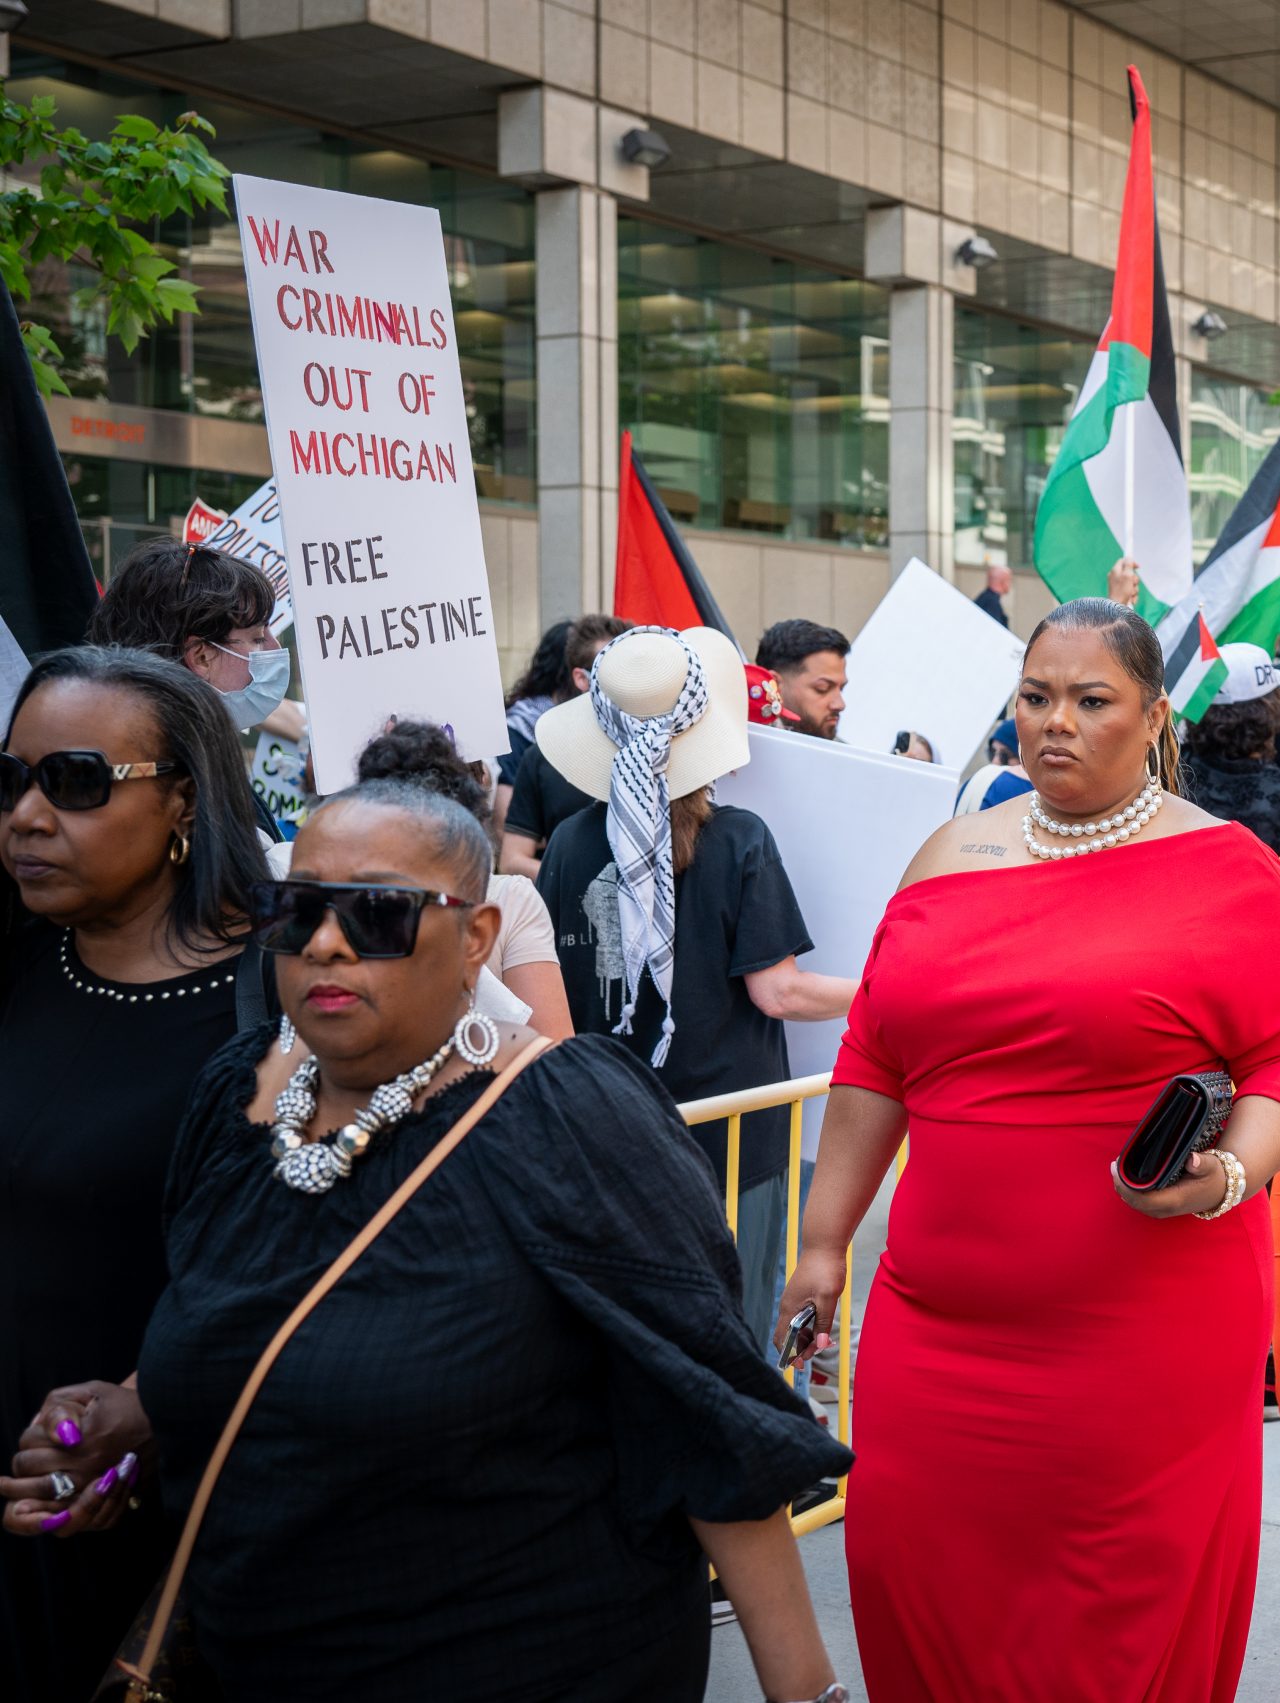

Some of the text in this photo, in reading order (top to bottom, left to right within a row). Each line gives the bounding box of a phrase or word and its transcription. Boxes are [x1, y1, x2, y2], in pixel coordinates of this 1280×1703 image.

[247, 216, 335, 274] WAR
[276, 284, 448, 350] CRIMINALS
[303, 362, 436, 415] OUT OF
[289, 430, 457, 484] MICHIGAN
[301, 535, 388, 586] FREE
[315, 596, 486, 659] PALESTINE
